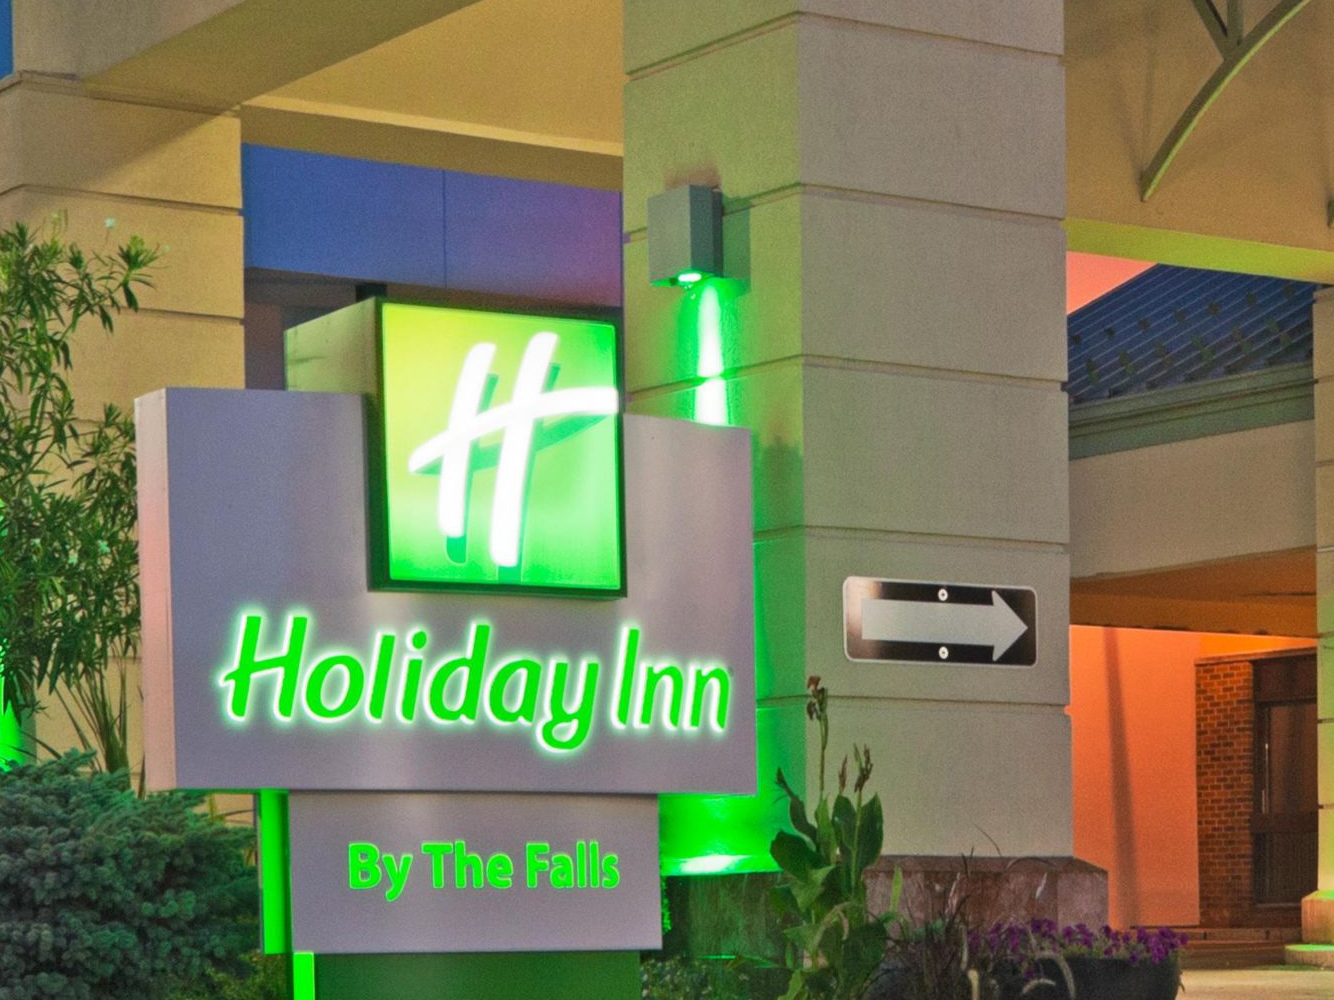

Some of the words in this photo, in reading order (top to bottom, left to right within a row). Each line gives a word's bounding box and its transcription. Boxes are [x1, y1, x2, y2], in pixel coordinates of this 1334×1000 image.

[218, 612, 600, 753] Holiday
[610, 625, 731, 733] Inn
[347, 842, 412, 901] By
[421, 840, 514, 889] The
[524, 841, 620, 889] Falls
